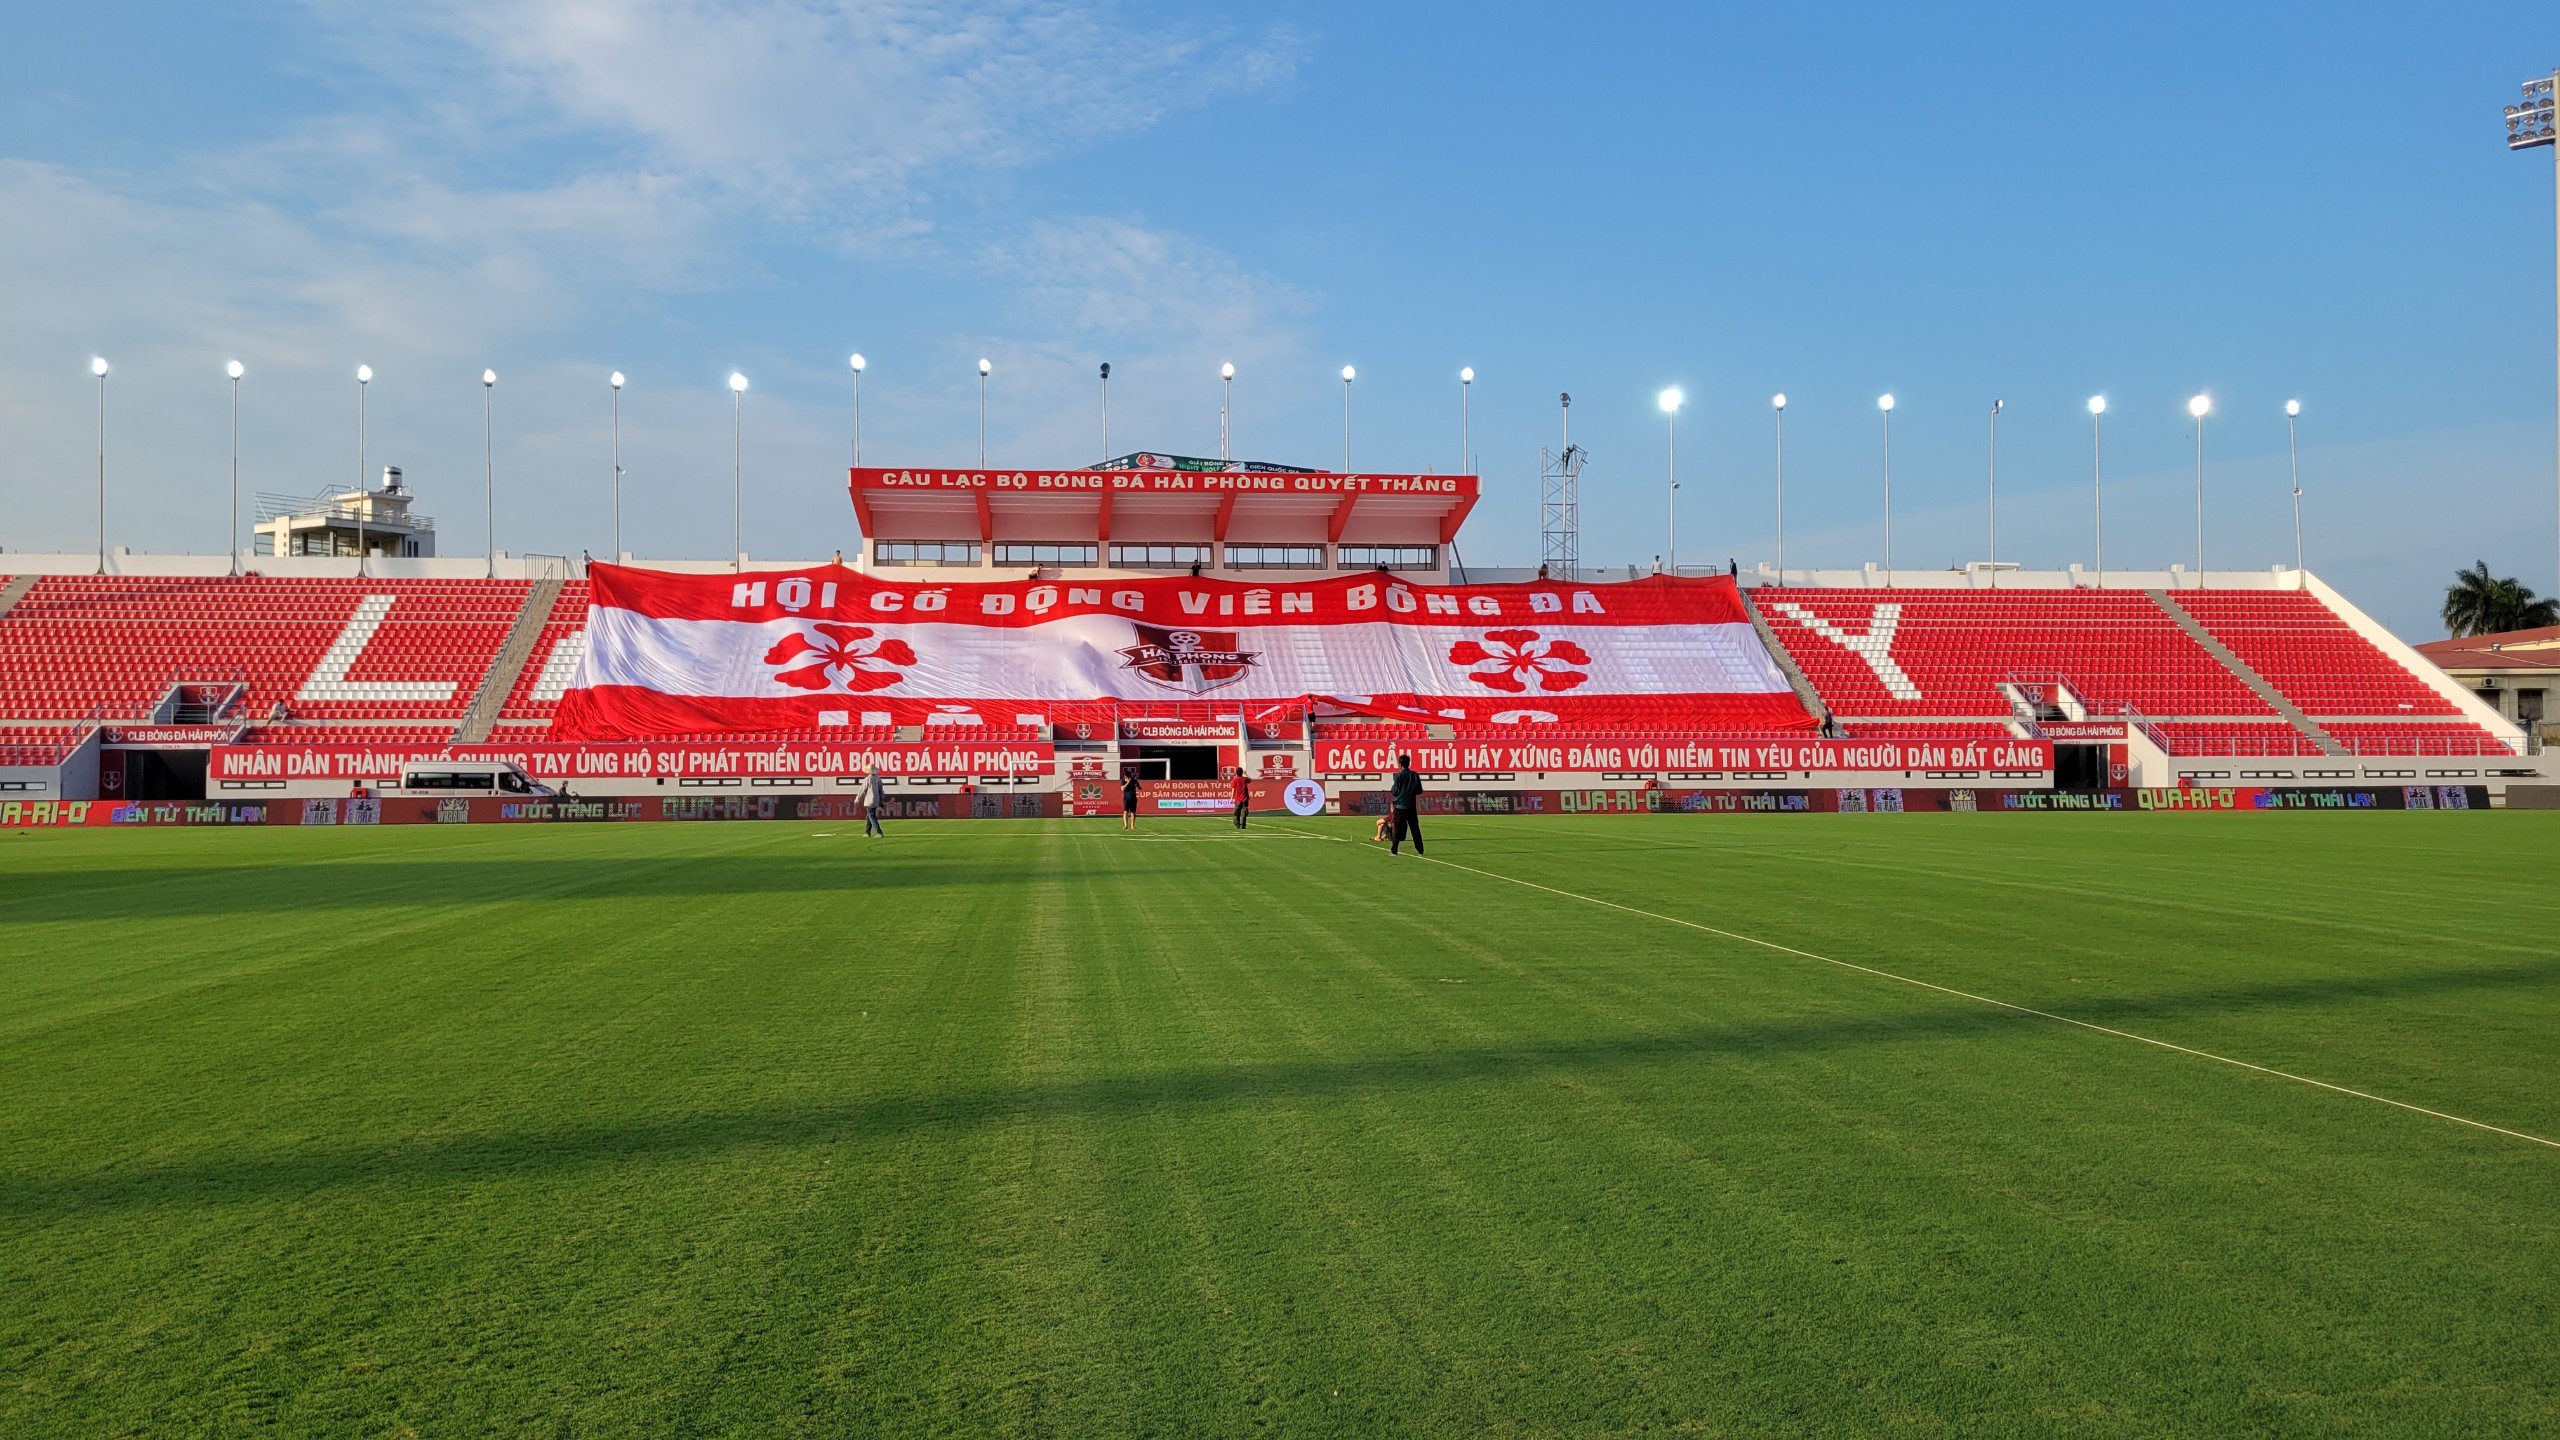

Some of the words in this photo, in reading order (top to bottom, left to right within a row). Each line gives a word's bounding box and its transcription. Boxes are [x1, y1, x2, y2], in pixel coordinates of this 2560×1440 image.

[883, 471, 931, 485] CÂU
[942, 473, 986, 489] LẠC
[996, 472, 1028, 489] BỘ
[1039, 473, 1103, 488] BÓNG
[1112, 473, 1145, 489] ĐÁ
[1154, 471, 1194, 489] HẢI
[1204, 474, 1285, 490] PHÒNG
[1294, 474, 1370, 491] QUYẾT
[1378, 475, 1456, 492] THẮNG
[731, 577, 838, 612] HỘI
[980, 585, 1144, 616] ĐỘNG
[1178, 588, 1313, 616] VIÊN
[1347, 583, 1501, 616] BÓNG
[1529, 591, 1605, 614] ĐÁ
[128, 731, 146, 741] CLB
[146, 728, 173, 741] BÓNG
[174, 728, 186, 741] ĐÁ
[188, 728, 203, 741] HẢI
[204, 728, 236, 741] PHÒNG
[1143, 726, 1158, 737] CLB
[1159, 726, 1182, 737] BÓNG
[1182, 725, 1193, 737] ĐÁ
[1194, 725, 1208, 737] HẢI
[1208, 725, 1235, 737] PHÒNG
[2041, 727, 2055, 736] CLB
[2056, 725, 2076, 736] BÓNG
[2076, 725, 2087, 736] ĐÁ
[2087, 725, 2099, 736] HẢI
[2100, 725, 2123, 736] PHÒNG
[224, 749, 280, 775] NHÂN
[287, 749, 330, 775] DÂN
[335, 749, 404, 775] THÀNH
[533, 753, 571, 774] TAY
[576, 747, 618, 774] ỦNG
[624, 748, 651, 777] HỘ
[657, 749, 684, 778] SỰ
[690, 747, 740, 773] PHÁT
[744, 743, 800, 773] TRIỂN
[805, 745, 844, 773] CỦA
[850, 747, 901, 773] BÓNG
[905, 747, 930, 772] ĐÁ
[937, 745, 968, 772] HẢI
[974, 747, 1038, 772] PHÒNG
[1328, 744, 1366, 770] CÁC
[1418, 743, 1457, 769] THỦ
[1464, 743, 1503, 769] HÃY
[1509, 743, 1562, 769] XỨNG
[1568, 743, 1621, 769] ĐÁNG
[1628, 744, 1659, 768] VỚI
[1666, 741, 1713, 768] NIỀM
[1719, 747, 1750, 767] TIN
[1756, 743, 1792, 768] YÊU
[1799, 742, 1837, 768] CỦA
[1843, 743, 1902, 768] NGƯỜI
[1908, 743, 1945, 767] DÂN
[1951, 740, 1987, 767] ĐẤT
[1993, 742, 2043, 767] CẢNG
[1171, 791, 1196, 799] NGỌC
[1172, 781, 1196, 789] BÓNG
[501, 800, 553, 819] NƯỚC
[557, 798, 604, 818] TĂNG
[1560, 791, 1663, 813] QUA-RI-Ơ
[1715, 793, 1737, 810] TỪ
[1741, 791, 1776, 810] THÁI
[1778, 795, 1810, 810] LAN
[2003, 791, 2047, 809] NƯỚC
[2049, 790, 2090, 809] TĂNG
[2092, 793, 2122, 811] LỰC
[2137, 789, 2235, 810] QUA-RI-Ơ
[2285, 790, 2307, 807] TỪ
[2310, 789, 2345, 807] THÁI
[2347, 793, 2378, 807] LAN
[0, 801, 92, 824] A-RI-Ơ
[154, 802, 180, 823] TỪ
[185, 802, 226, 823] THÁI
[230, 806, 267, 822] LAN
[906, 801, 940, 817] LAN
